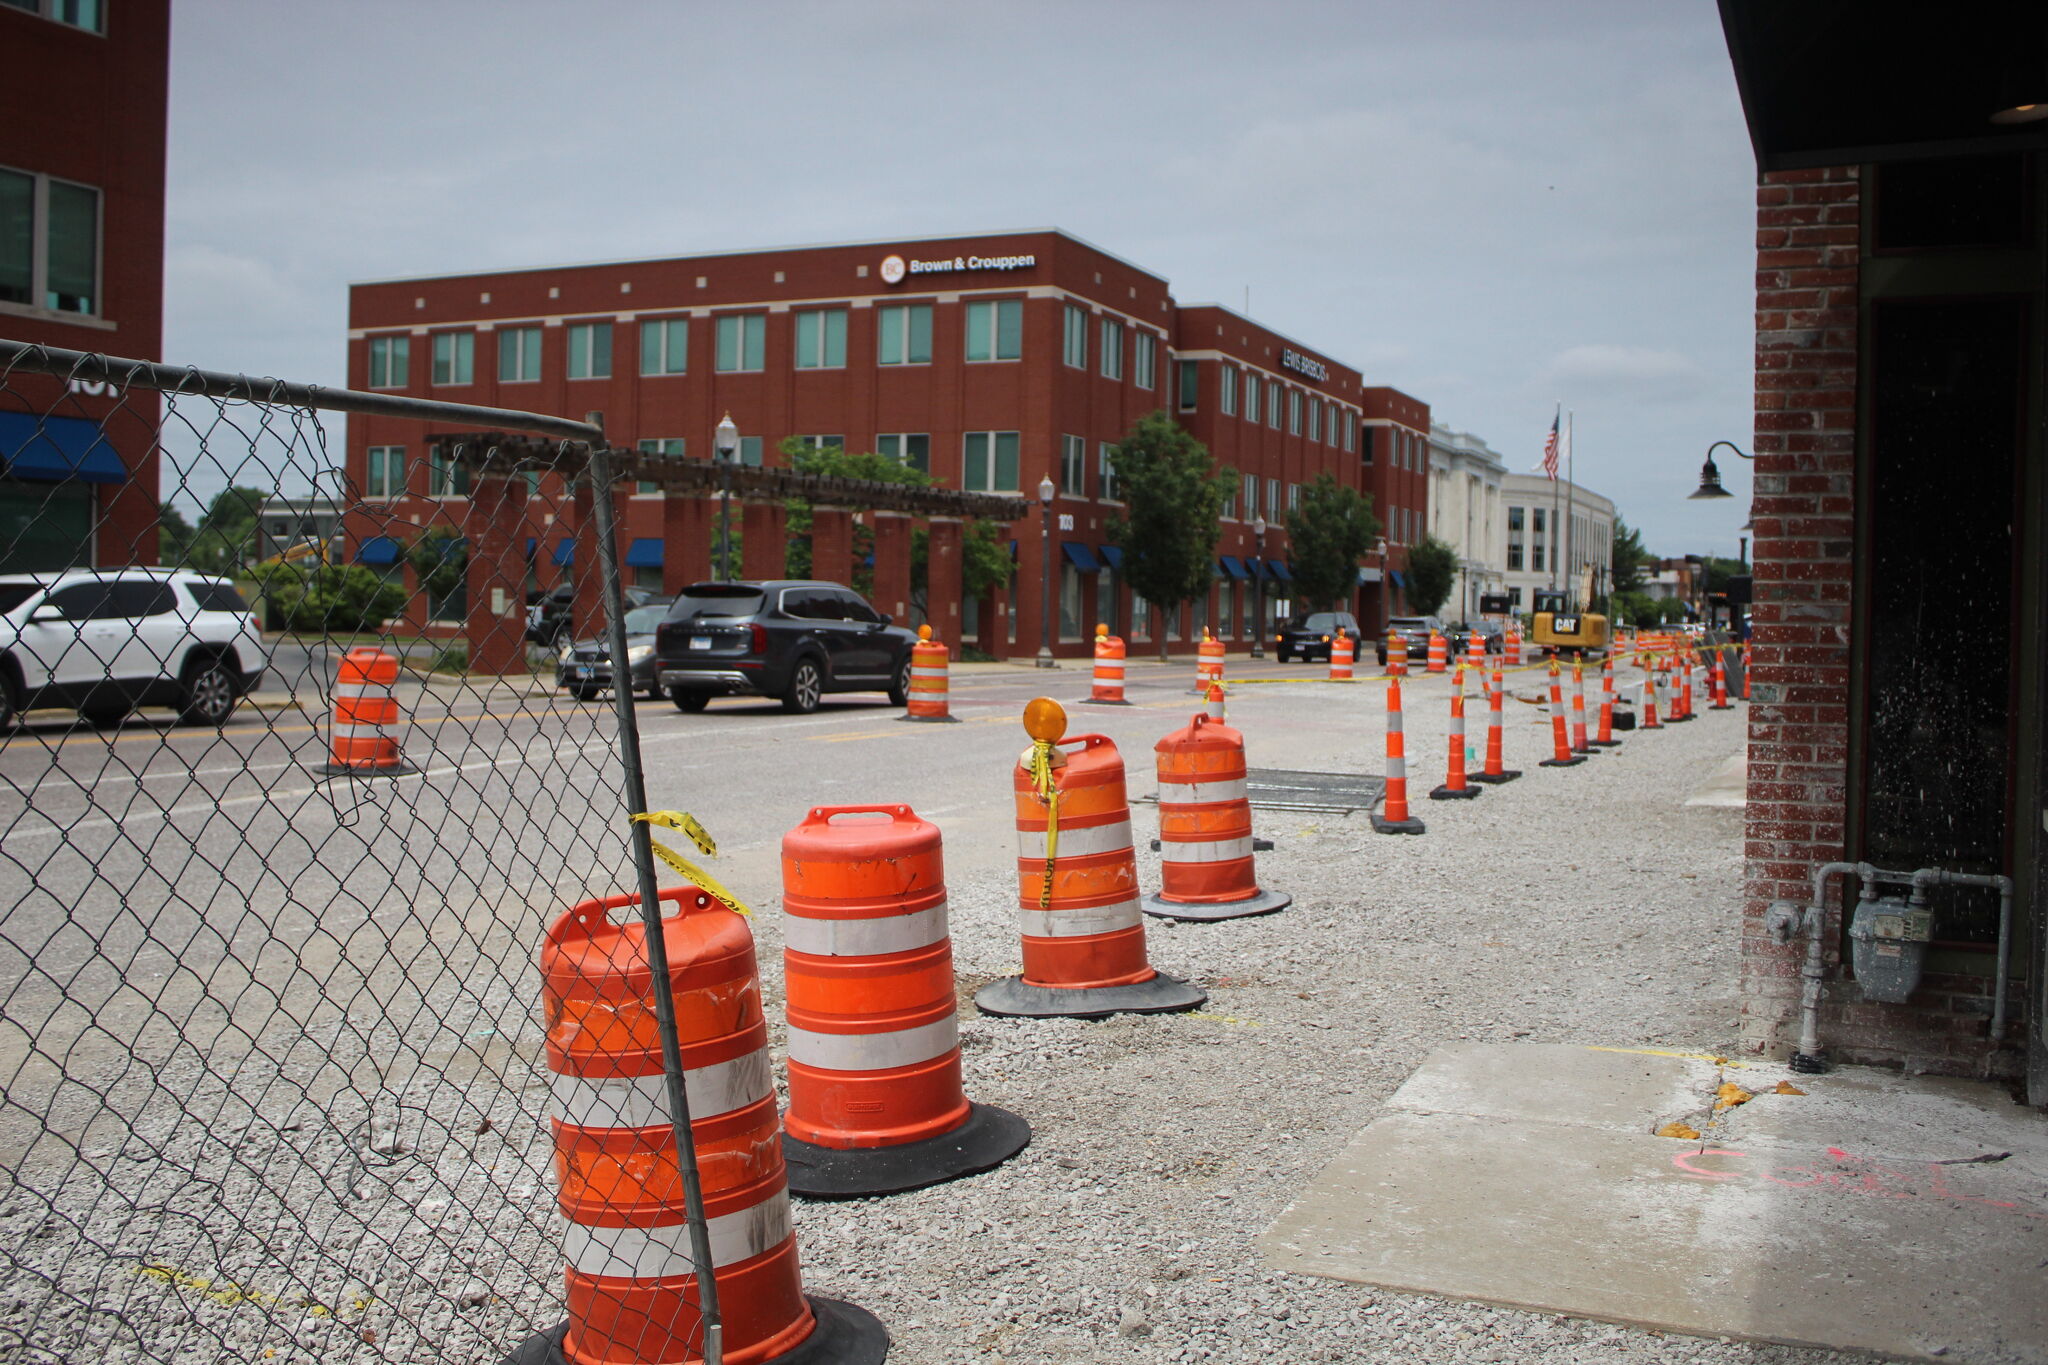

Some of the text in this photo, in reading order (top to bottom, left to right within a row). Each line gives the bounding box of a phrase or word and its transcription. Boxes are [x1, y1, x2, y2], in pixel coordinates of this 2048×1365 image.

[910, 254, 1035, 273] Brown & Crouppen
[1283, 347, 1301, 371] LEWIS
[1059, 513, 1074, 531] 103
[1554, 618, 1577, 632] CAT
